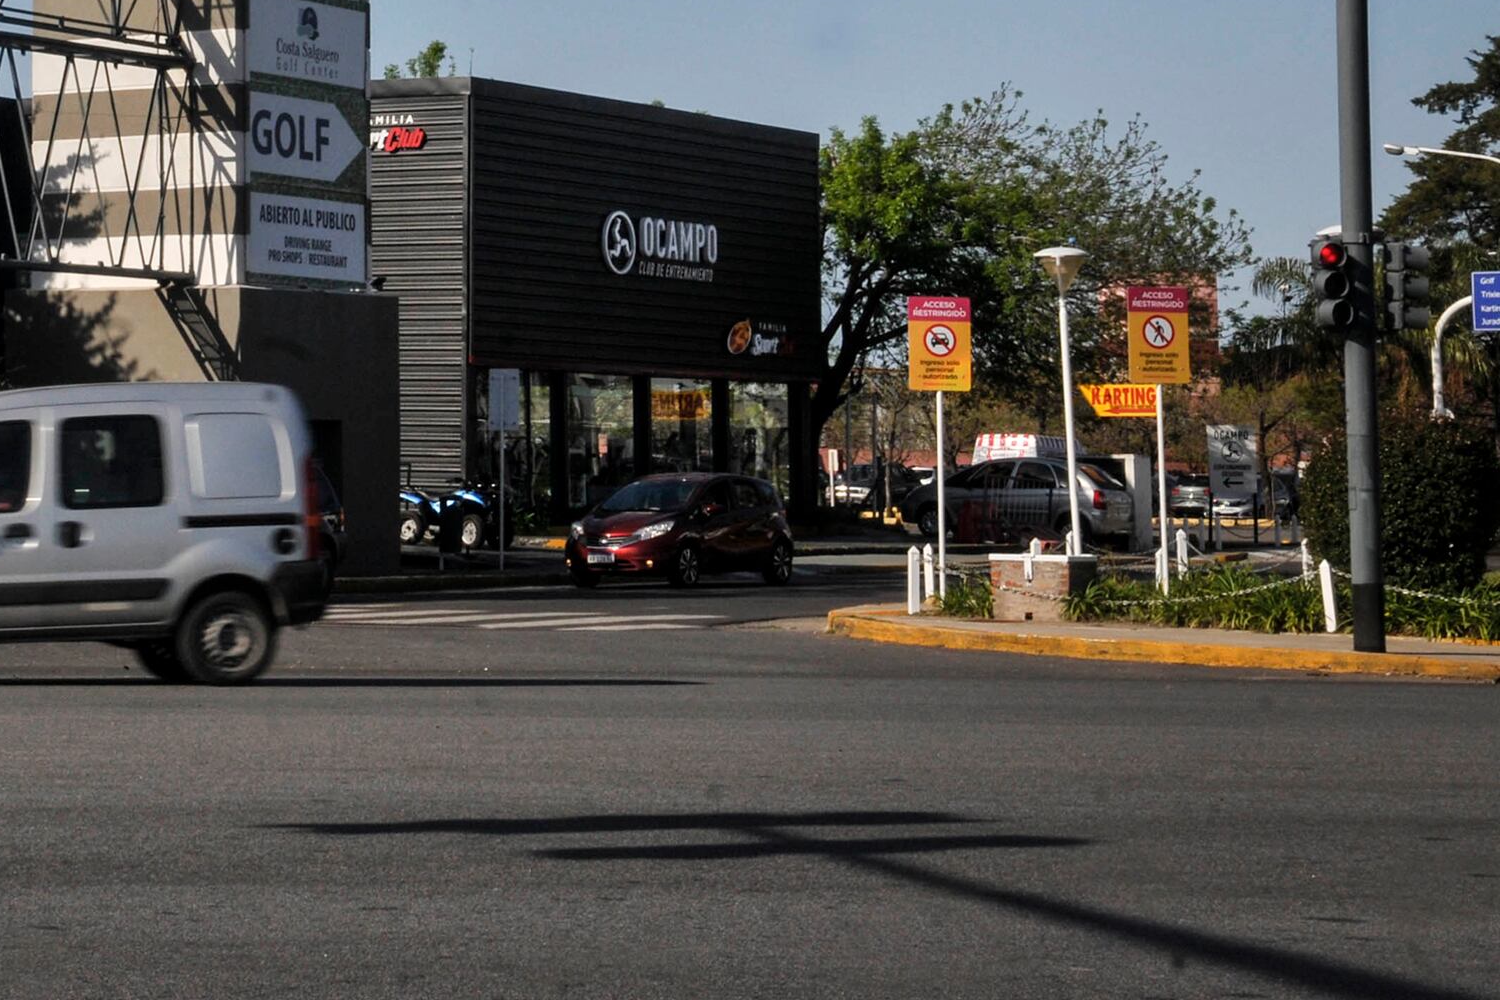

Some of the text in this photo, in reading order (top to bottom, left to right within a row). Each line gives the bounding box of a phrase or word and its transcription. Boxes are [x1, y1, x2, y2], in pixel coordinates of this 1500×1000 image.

[276, 37, 339, 63] Costa Salguero
[370, 114, 414, 126] MILIA
[252, 109, 330, 162] GOLF
[260, 204, 356, 232] ABIERTO AL PUBLICO
[284, 235, 310, 250] DRIVING
[640, 216, 718, 264] OCAMPO
[268, 249, 282, 262] PRO
[282, 251, 302, 264] SHOPS
[639, 260, 655, 277] CLUB
[655, 263, 665, 278] DE
[1143, 291, 1174, 299] ACCESO
[923, 300, 956, 308] ACCESO
[1132, 300, 1184, 308] RESTRINGIDO
[913, 309, 966, 317] RESTRINGIDO
[1091, 387, 1157, 406] KARTING
[1214, 430, 1249, 440] OCAMPO
